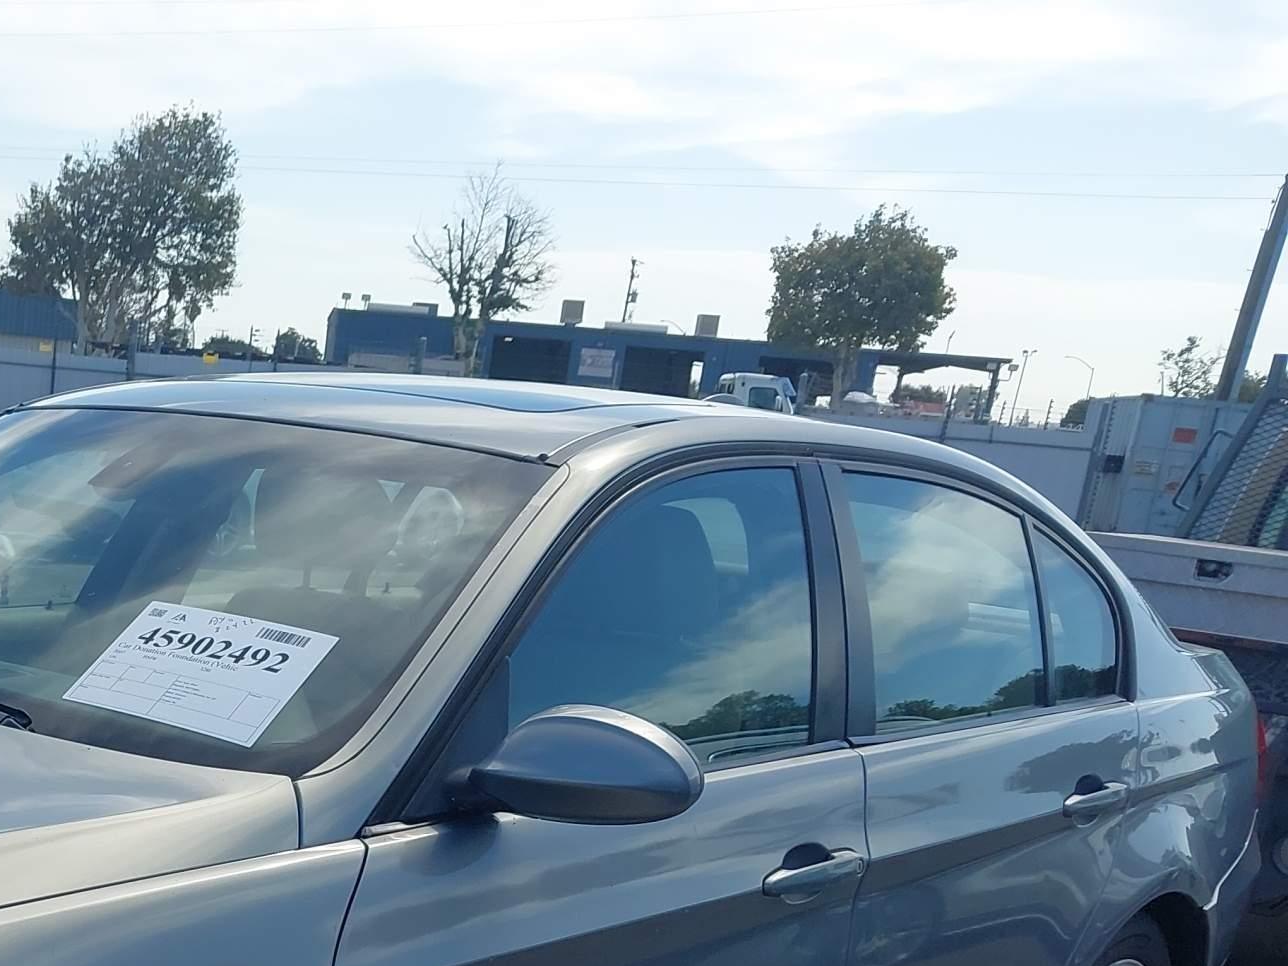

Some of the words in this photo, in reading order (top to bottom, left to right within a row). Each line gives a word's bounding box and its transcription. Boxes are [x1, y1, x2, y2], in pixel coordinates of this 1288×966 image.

[118, 641, 132, 650] Car
[132, 643, 167, 657] Donation
[168, 651, 210, 666] Foundation
[137, 627, 289, 674] 45902492
